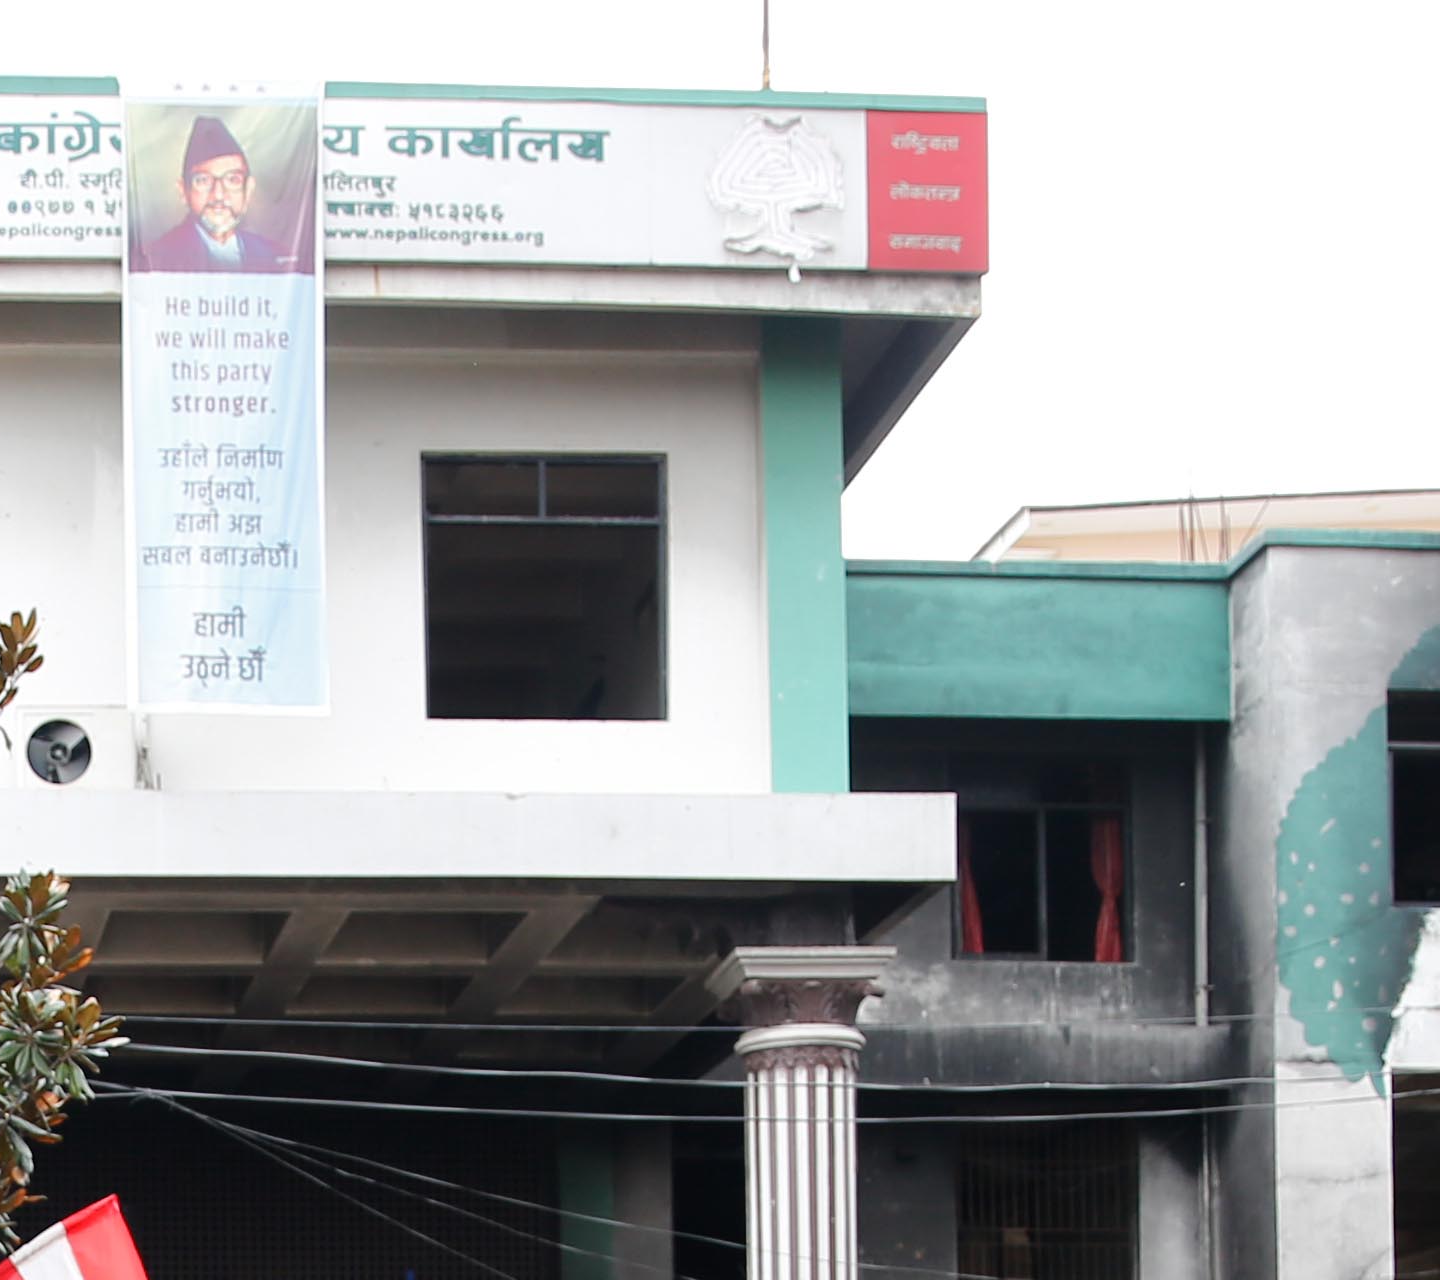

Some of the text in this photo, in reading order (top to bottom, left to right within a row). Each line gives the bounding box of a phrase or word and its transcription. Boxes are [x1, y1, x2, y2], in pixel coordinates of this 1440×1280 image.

[385, 116, 611, 163] कार्यालय
[164, 297, 192, 318] He
[197, 295, 250, 318] build
[155, 327, 290, 350] we will make
[171, 359, 273, 385] this party
[171, 394, 278, 418] stronger.
[216, 442, 285, 470] निर्माण
[174, 508, 263, 536] हामी अझ
[192, 605, 247, 638] हामी
[179, 646, 231, 688] उठ्ने
